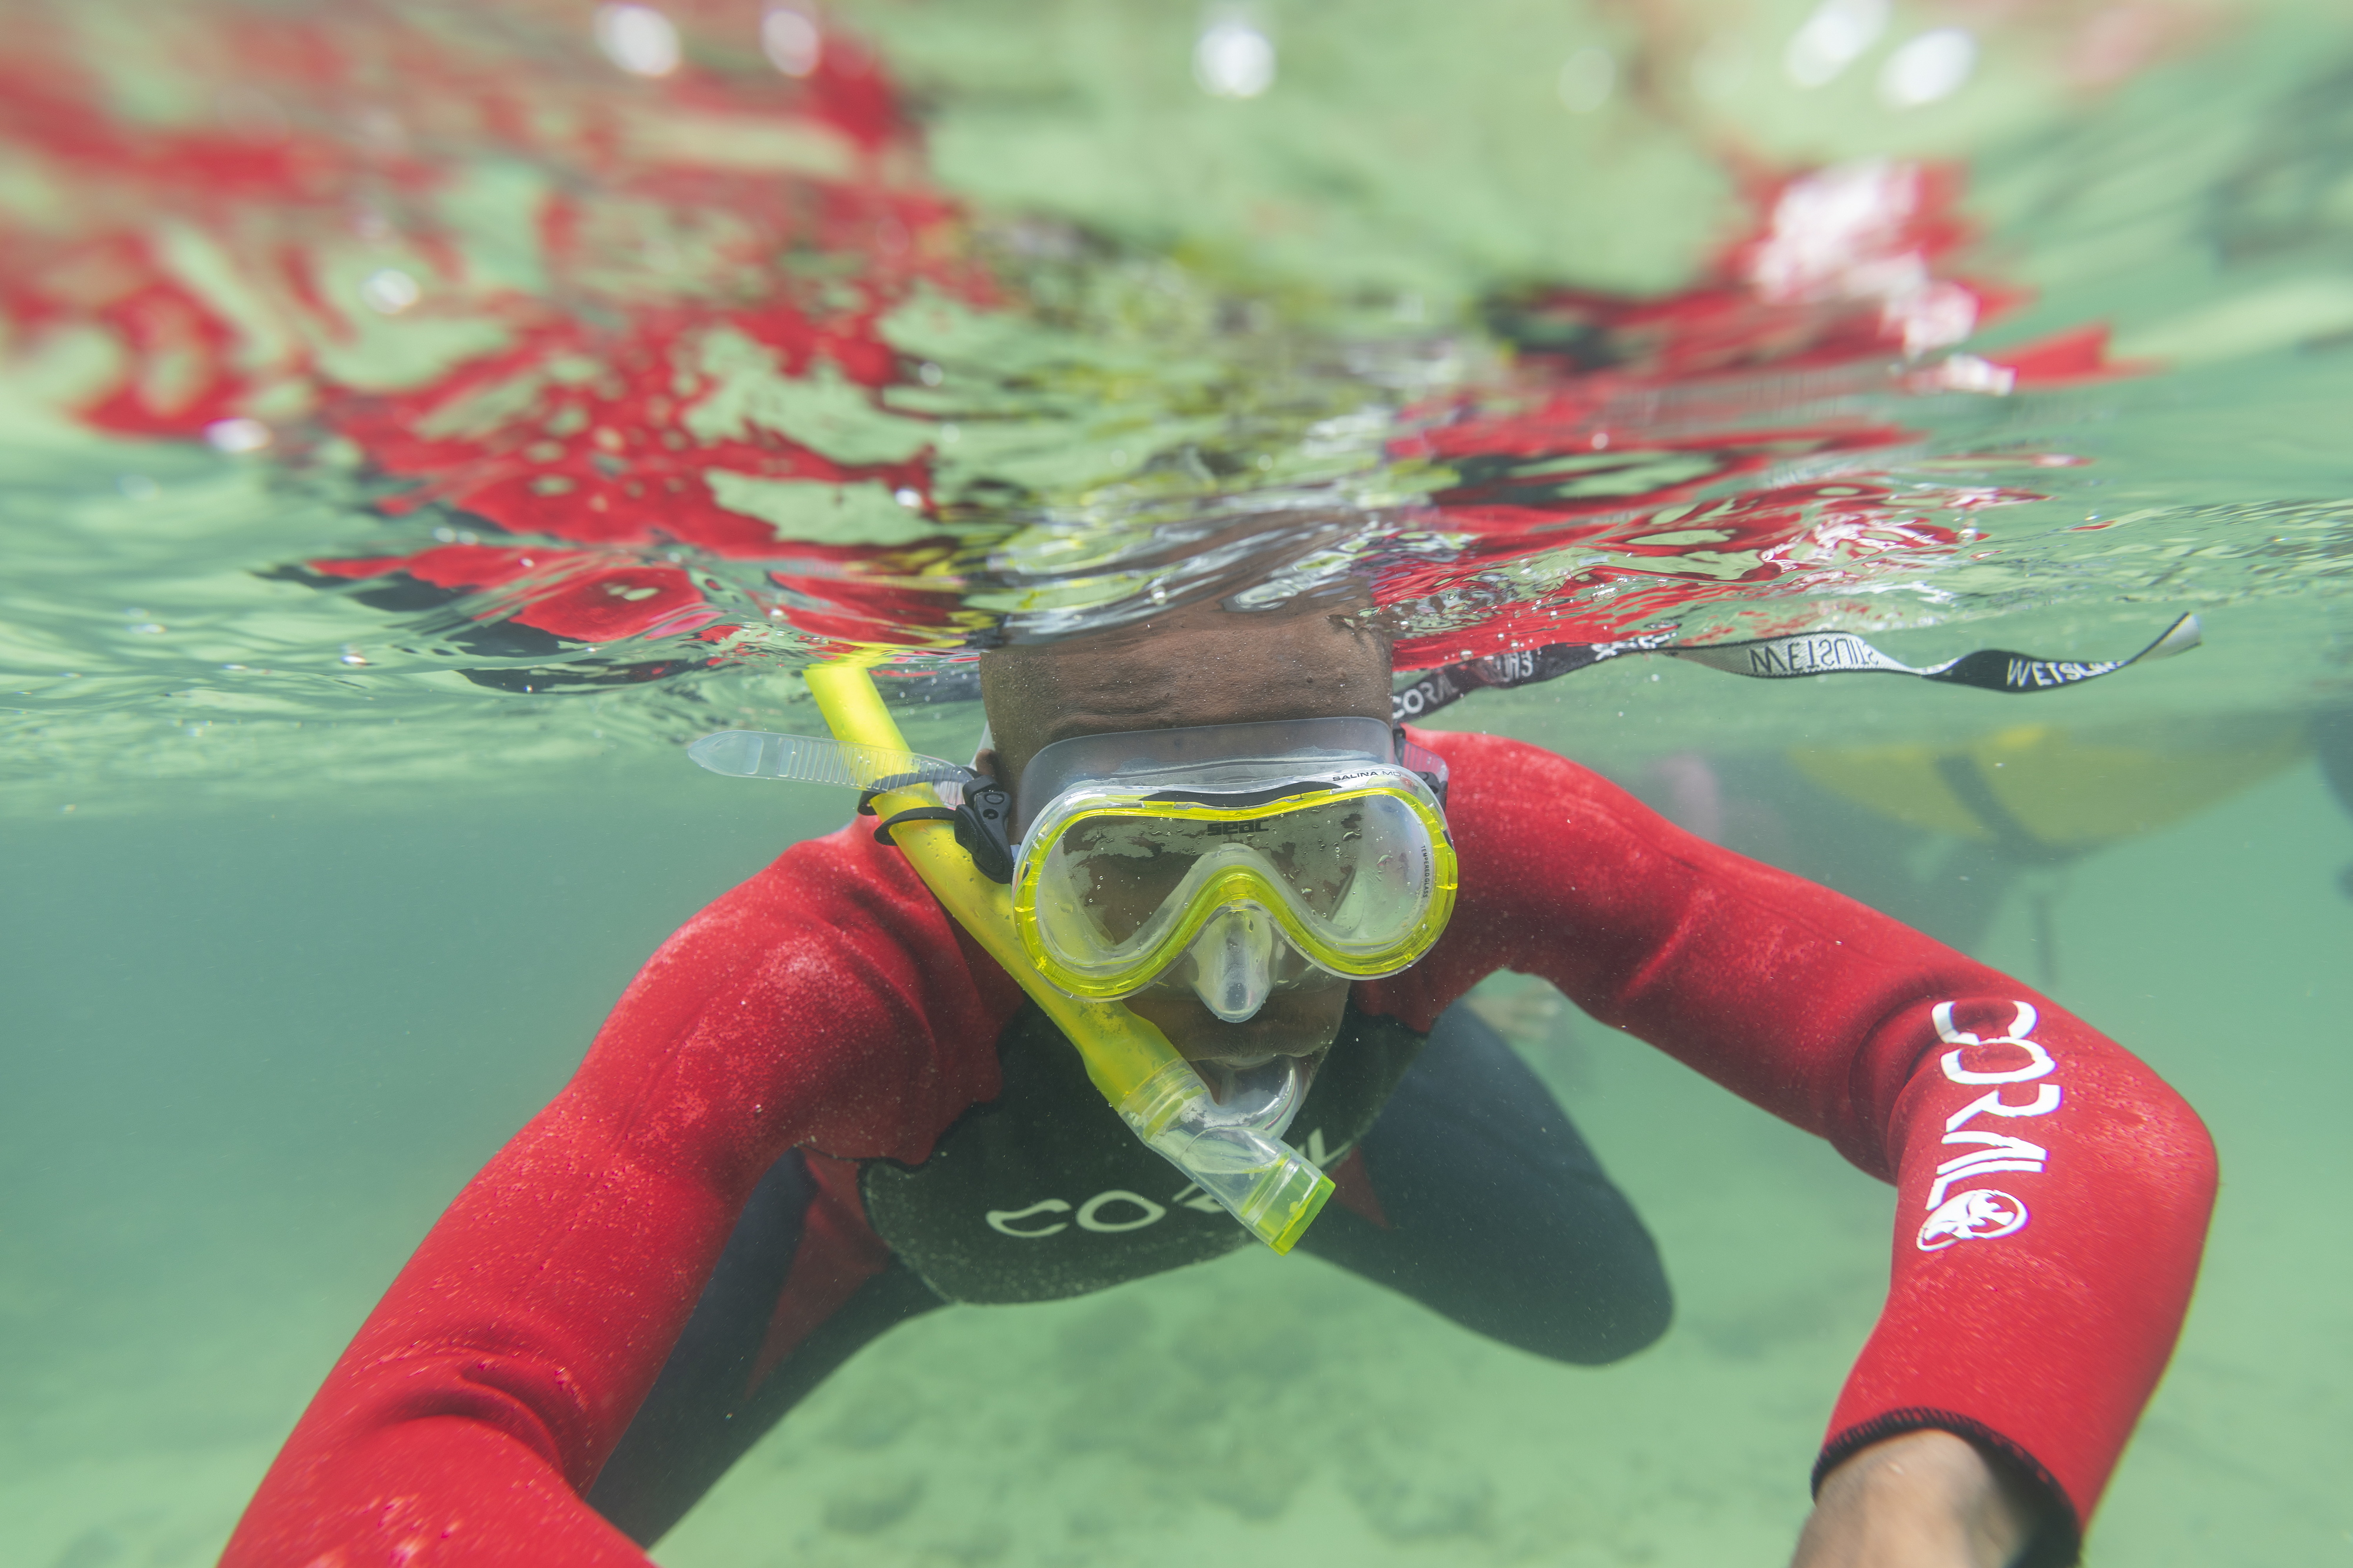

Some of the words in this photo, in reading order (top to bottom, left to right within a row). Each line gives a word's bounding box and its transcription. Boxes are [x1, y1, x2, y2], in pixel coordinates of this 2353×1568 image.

[1332, 771, 1378, 781] SALINA
[1207, 819, 1269, 836] seac
[1421, 845, 1429, 877] TEMPERED
